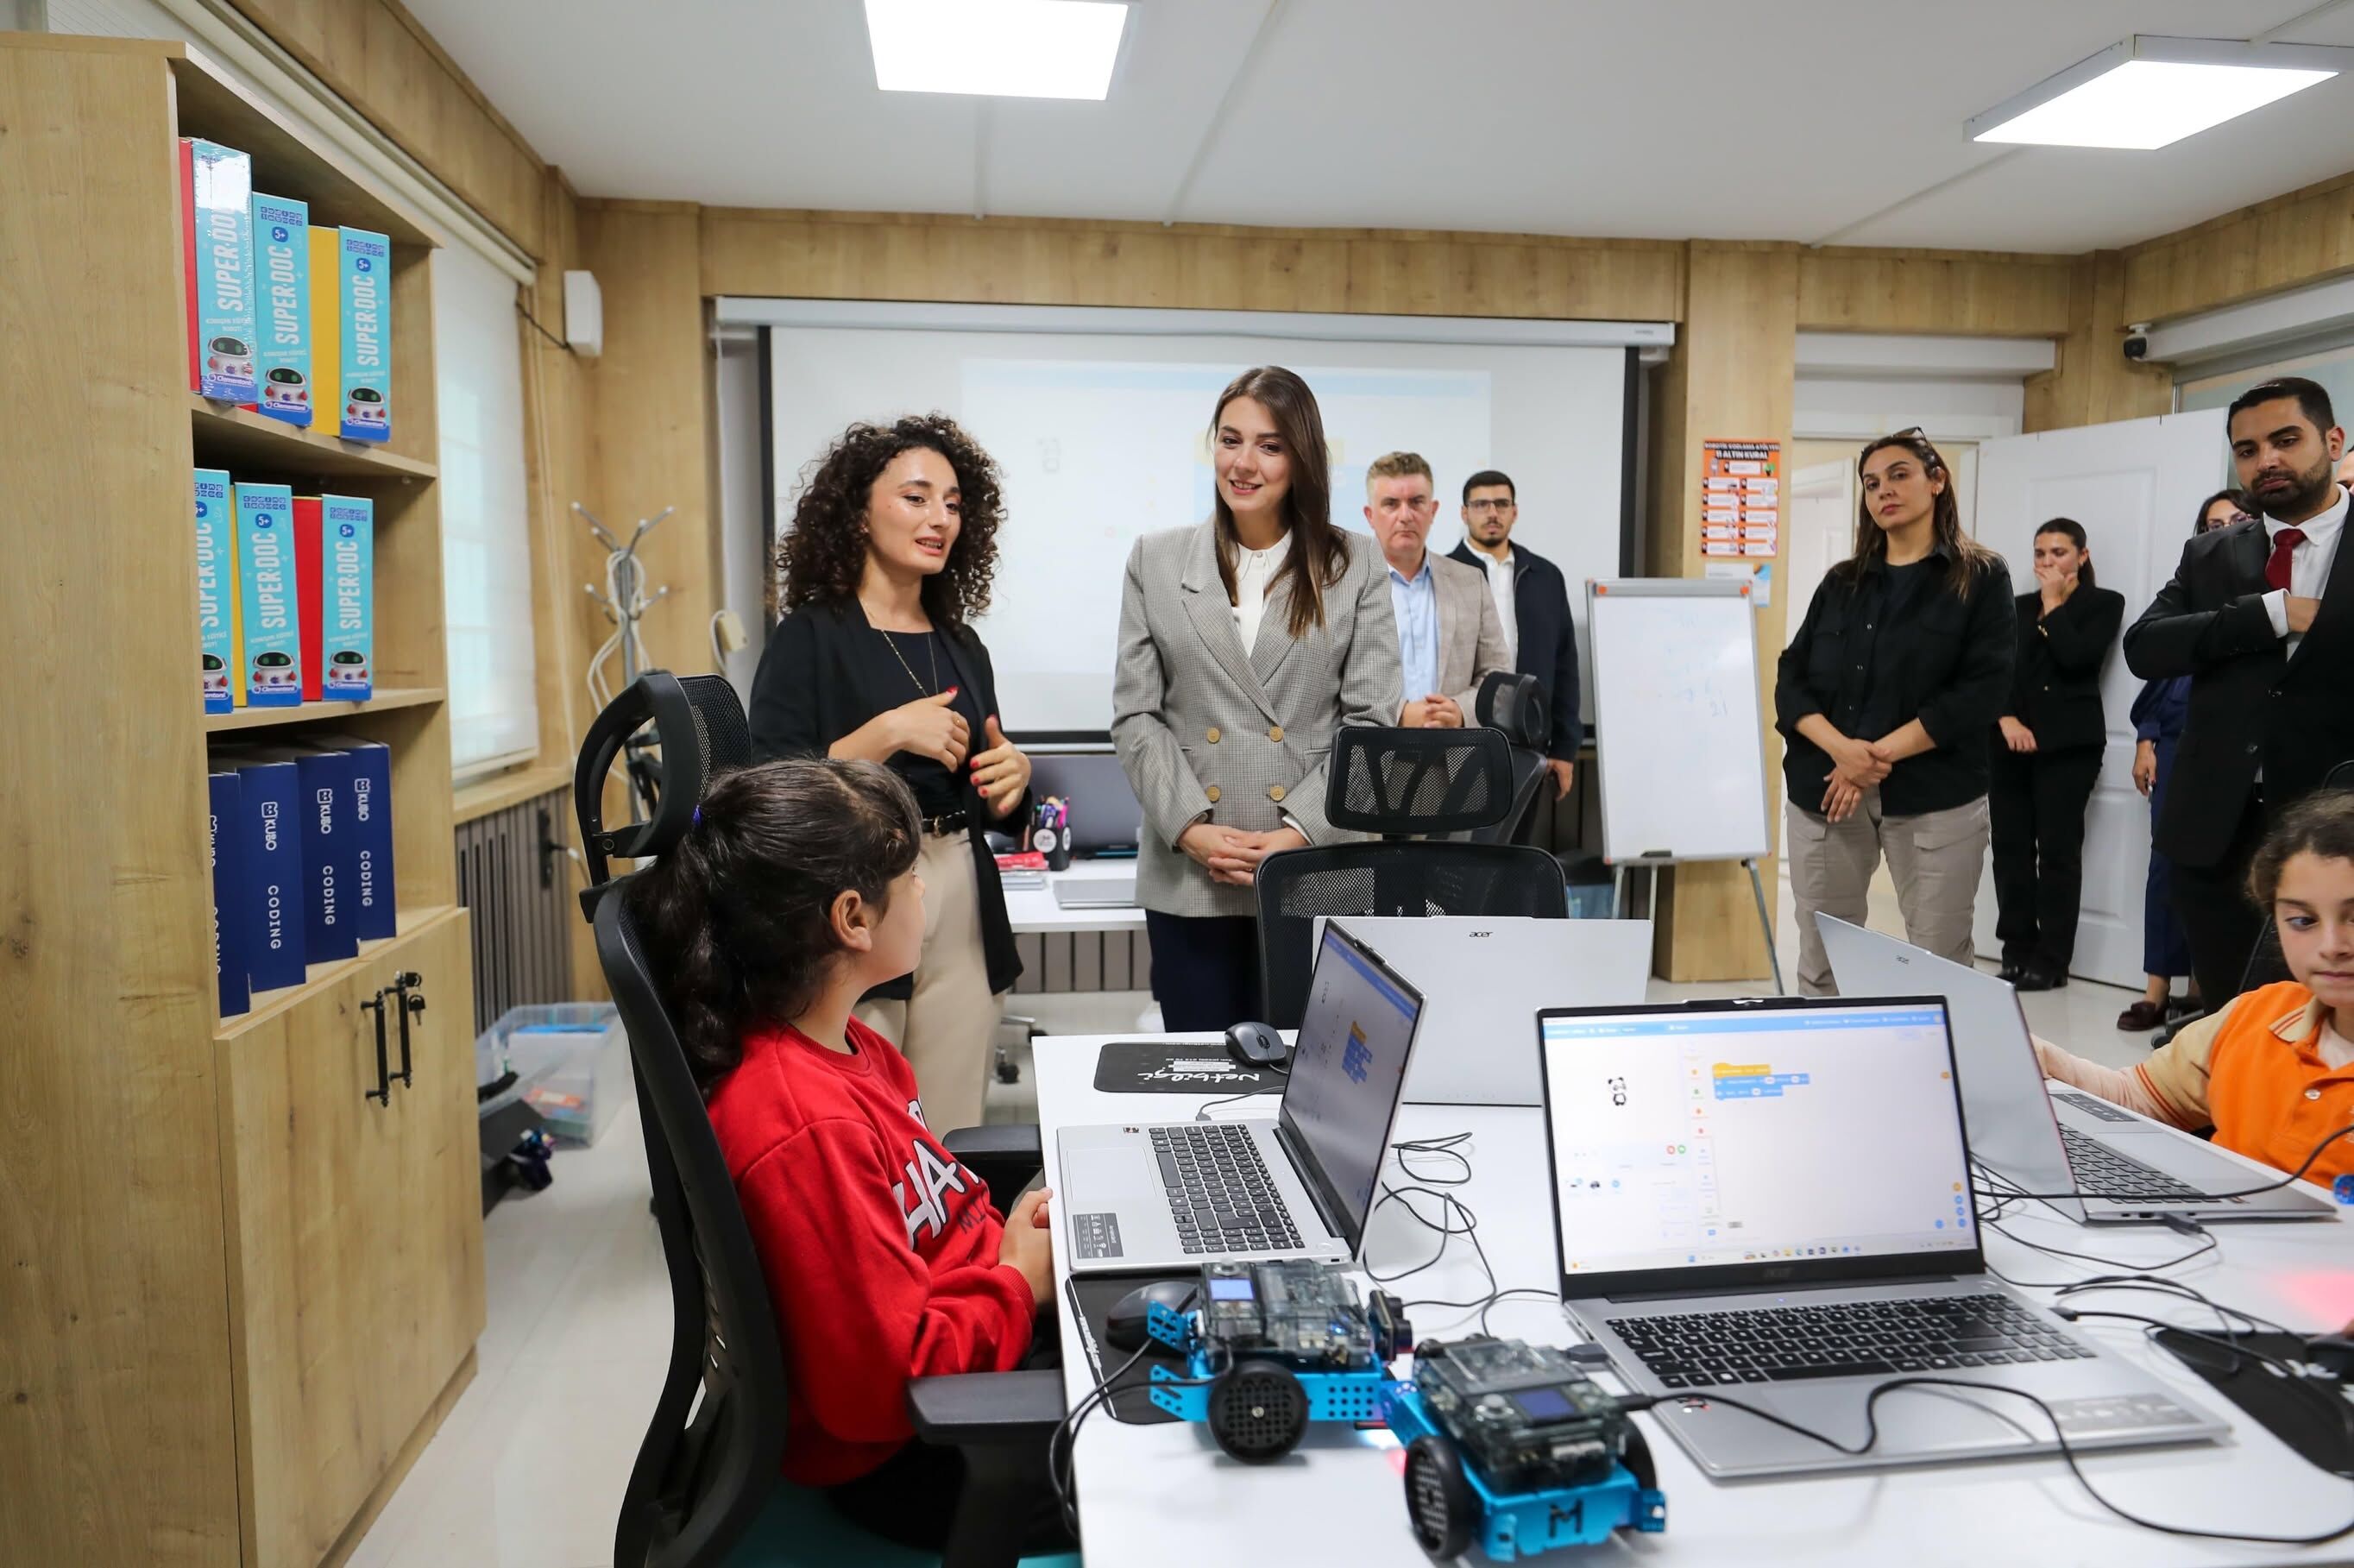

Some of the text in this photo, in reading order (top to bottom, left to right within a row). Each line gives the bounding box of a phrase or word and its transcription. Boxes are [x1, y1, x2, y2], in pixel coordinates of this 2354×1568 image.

[264, 818, 277, 851] KUBO
[319, 803, 331, 834] KUBO
[323, 865, 336, 925] CODING
[360, 850, 373, 907] CODING
[268, 885, 281, 949] CODING
